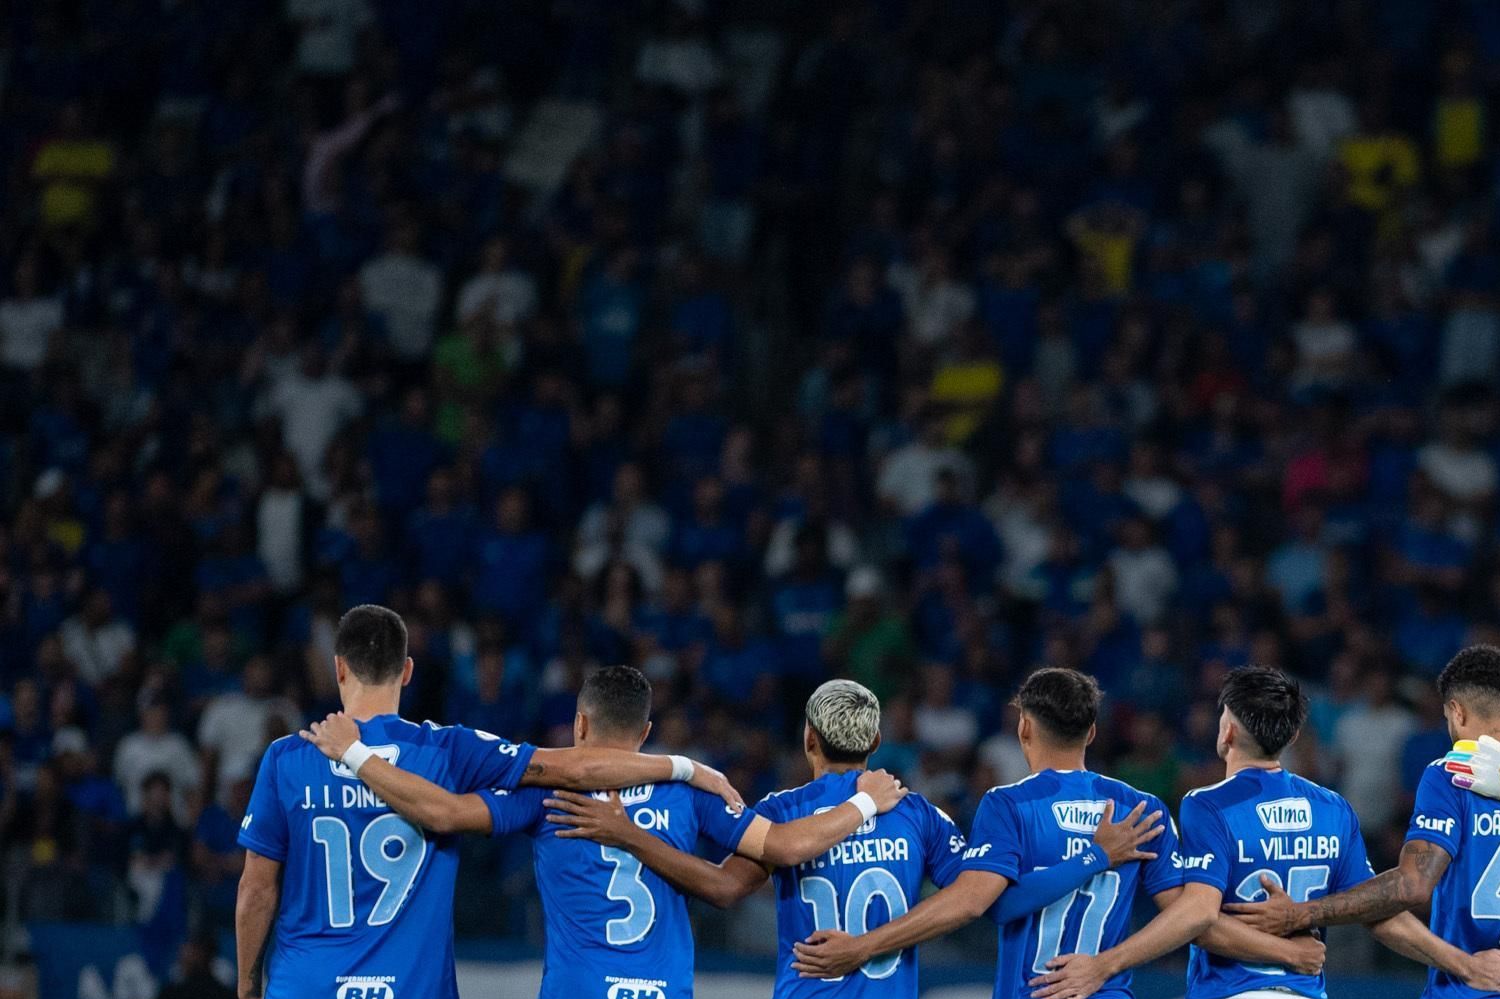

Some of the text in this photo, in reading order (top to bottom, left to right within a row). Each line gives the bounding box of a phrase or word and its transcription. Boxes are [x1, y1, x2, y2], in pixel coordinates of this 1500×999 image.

[302, 785, 390, 810] J. I. DINE
[1261, 806, 1308, 824] Vilma
[1415, 814, 1456, 836] Surf
[829, 838, 908, 866] PEREIRA
[1238, 836, 1340, 864] L. VILLALBA
[312, 813, 427, 928] 19
[600, 843, 656, 945] 3
[800, 866, 909, 981] 10
